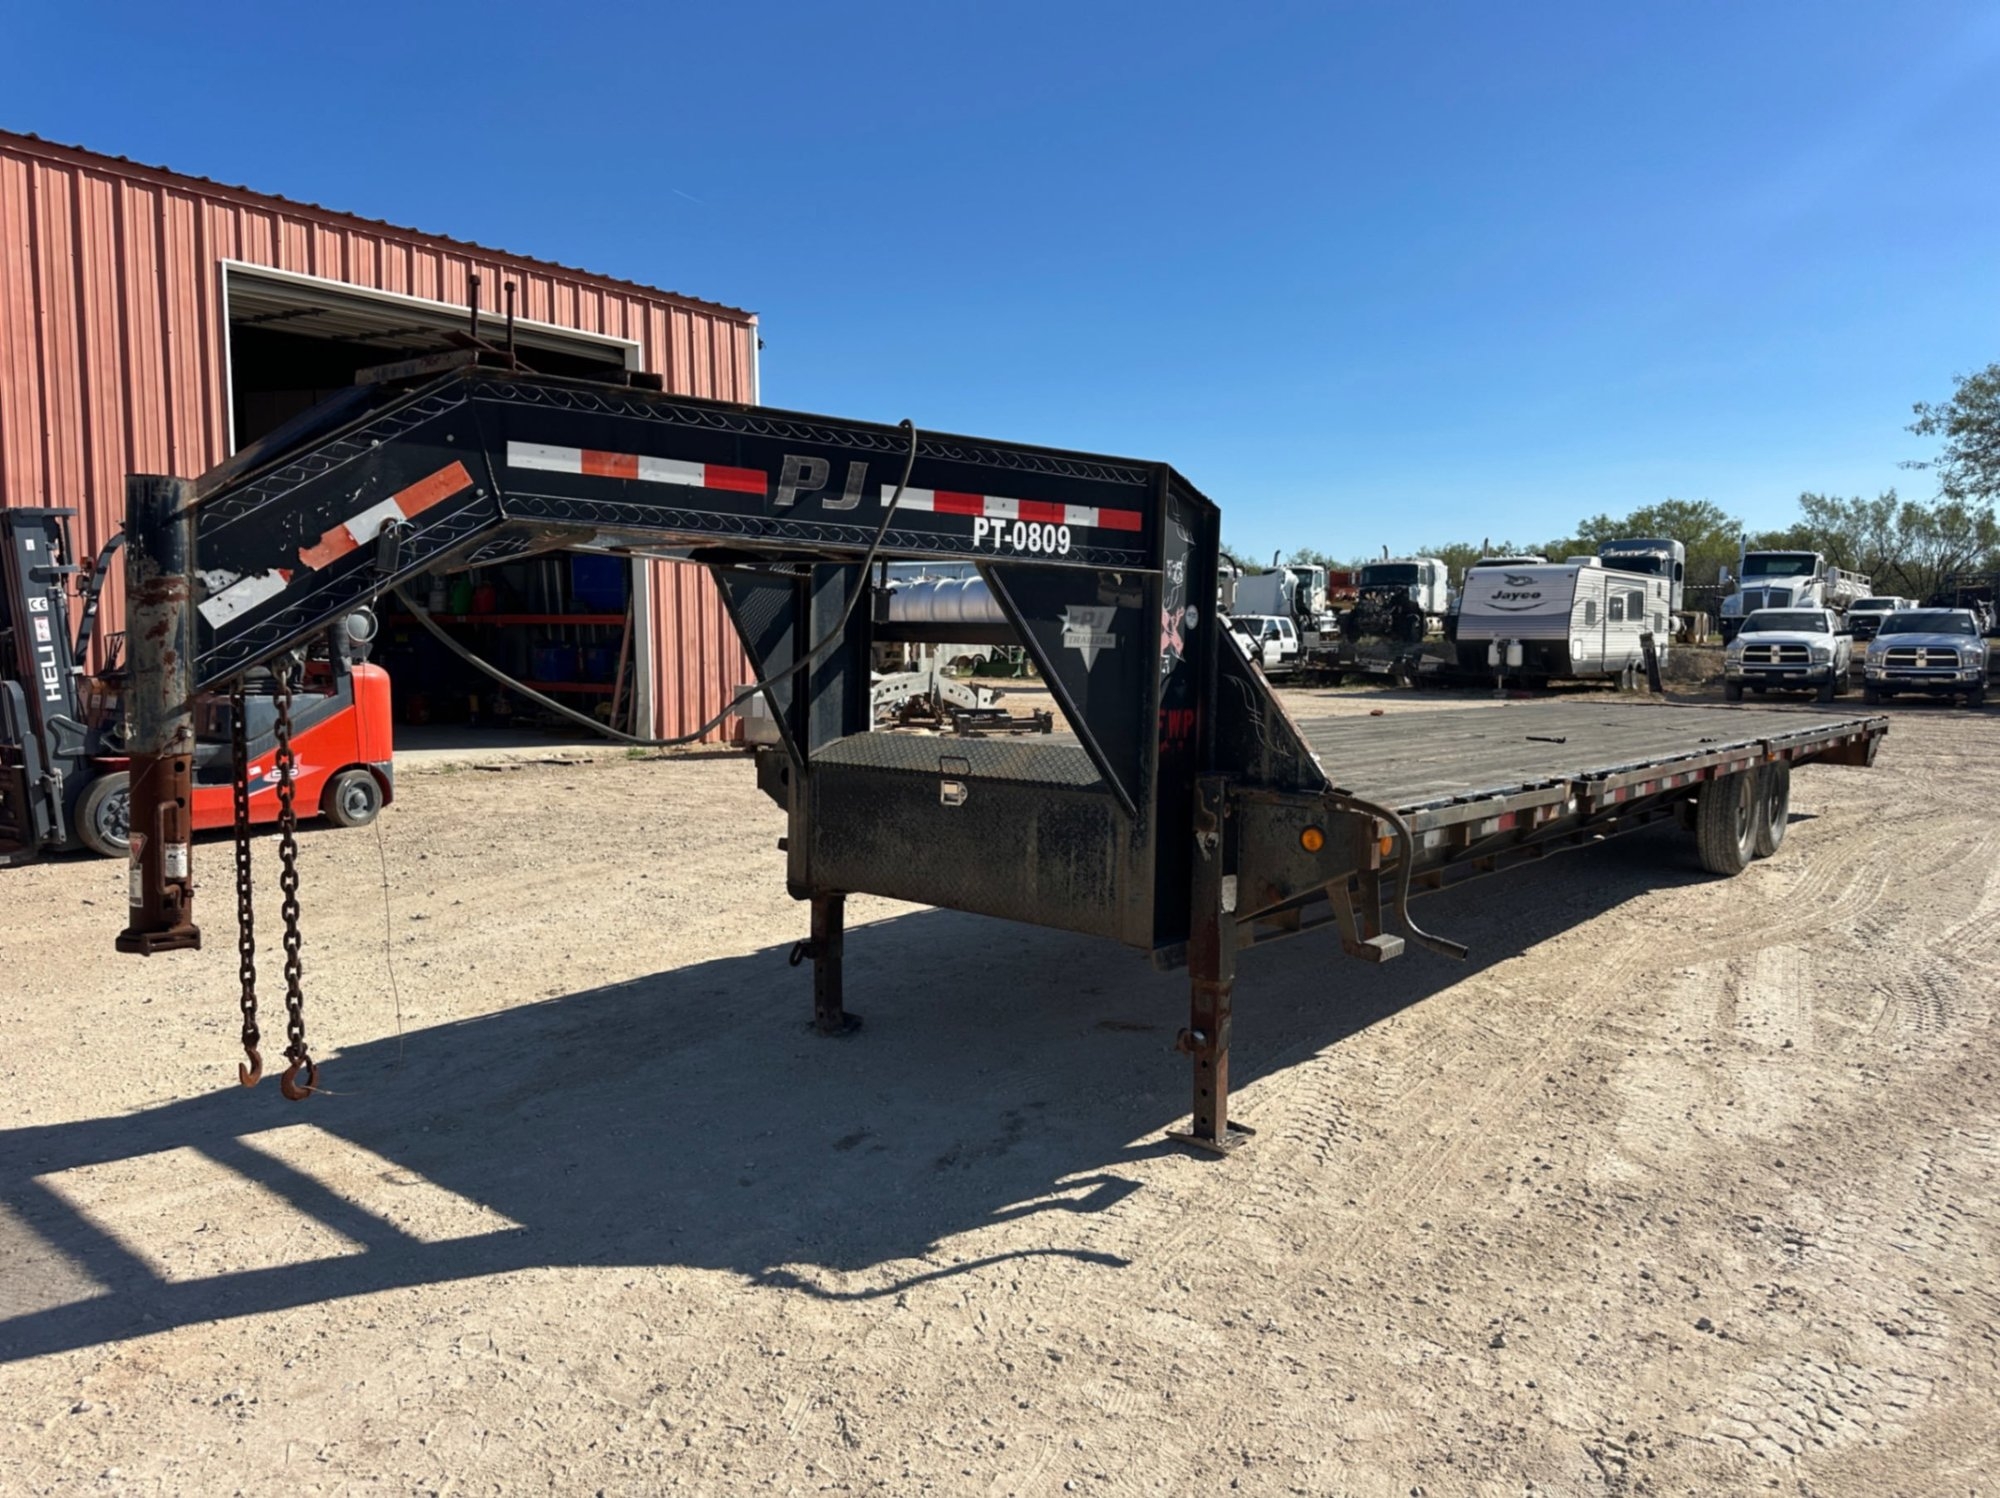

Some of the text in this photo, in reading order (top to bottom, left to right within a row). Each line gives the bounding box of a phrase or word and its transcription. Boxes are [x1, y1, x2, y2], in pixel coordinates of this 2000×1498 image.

[773, 454, 869, 511] PJ
[973, 516, 1071, 555] PT-0809
[30, 599, 47, 610] CE
[1491, 590, 1542, 601] Jayco
[1066, 635, 1114, 645] TRAILERS
[38, 645, 62, 701] HELI
